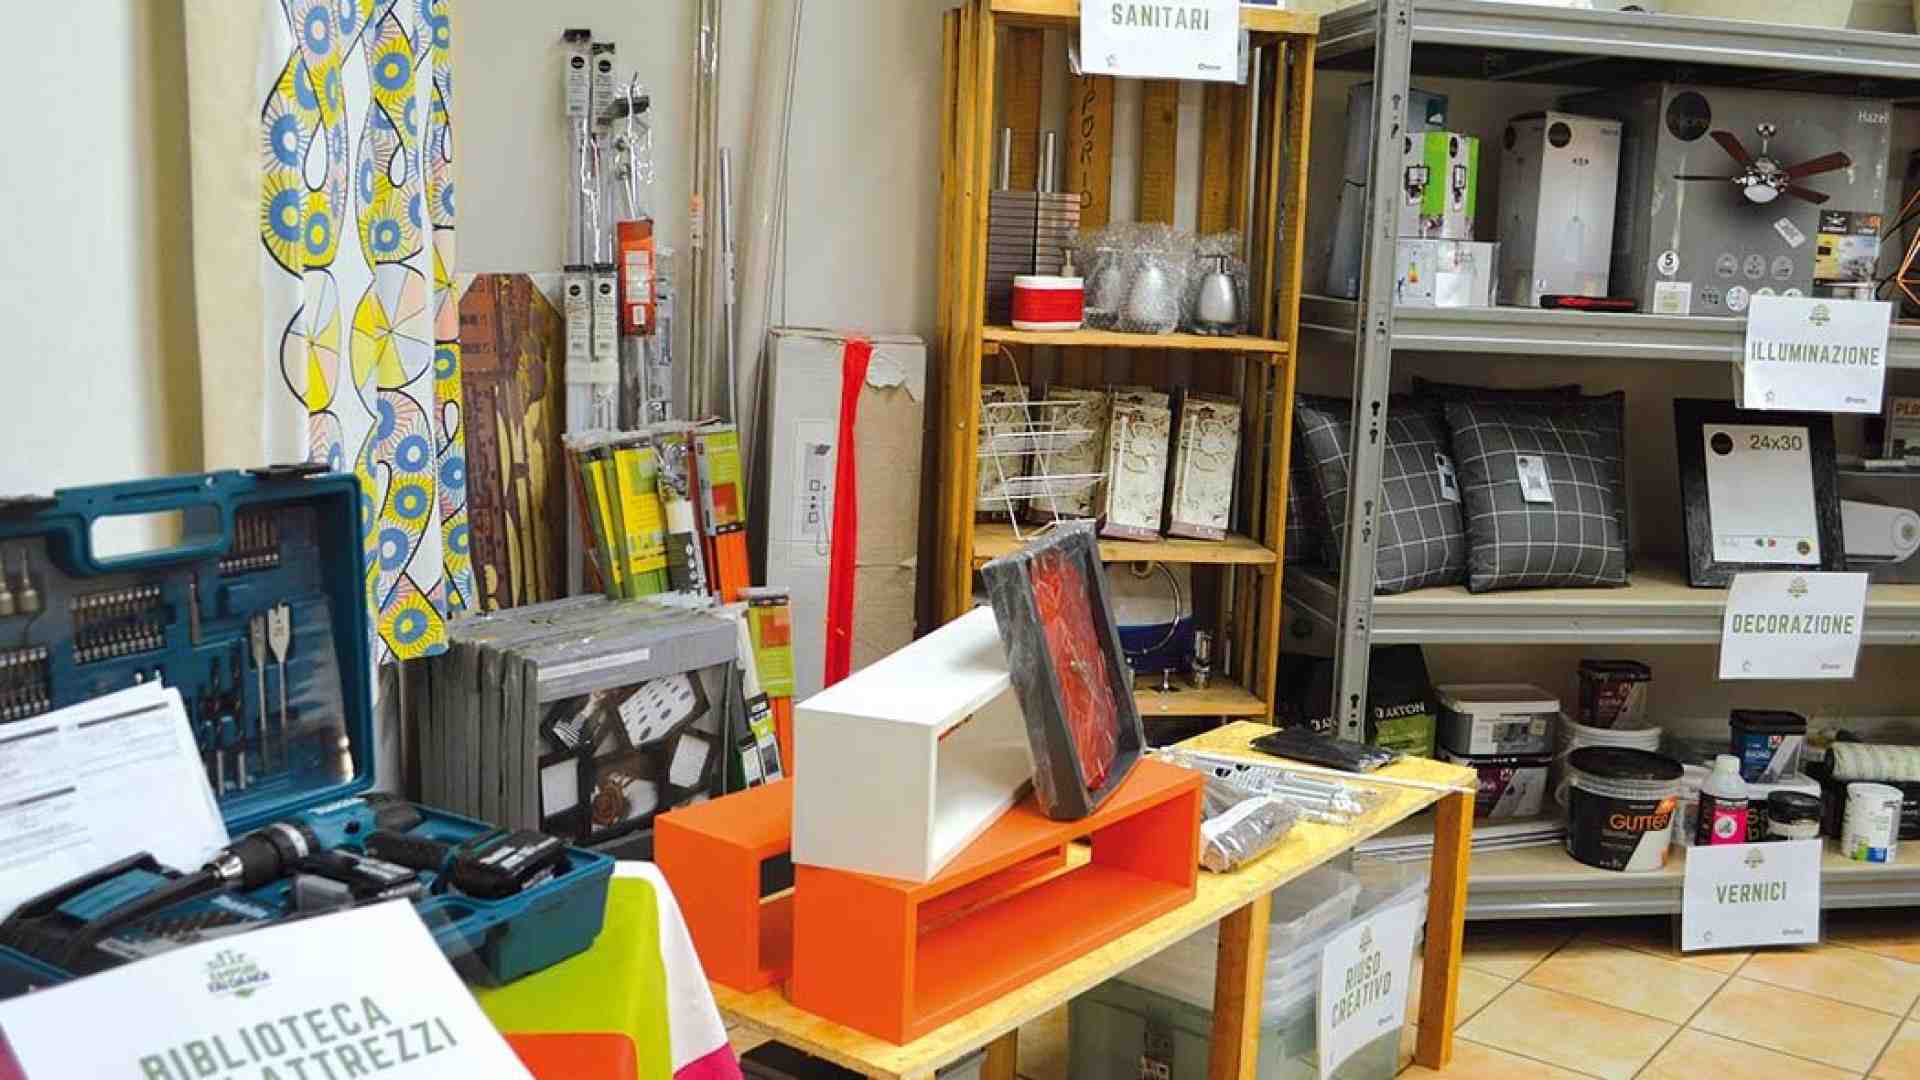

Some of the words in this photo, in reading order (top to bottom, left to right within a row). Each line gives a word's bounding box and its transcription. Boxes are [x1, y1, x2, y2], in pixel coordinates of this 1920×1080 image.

[1112, 3, 1209, 31] SANITARI
[1751, 341, 1880, 366] ILLUMINAZIONE
[1750, 433, 1803, 450] 24x30
[1732, 613, 1856, 634] DECORAZIONE
[1716, 881, 1788, 904] VERNICI
[1345, 951, 1381, 993] RIUSO
[1332, 971, 1392, 1029] CREATIVO
[140, 995, 392, 1080] BIBLIOTECA
